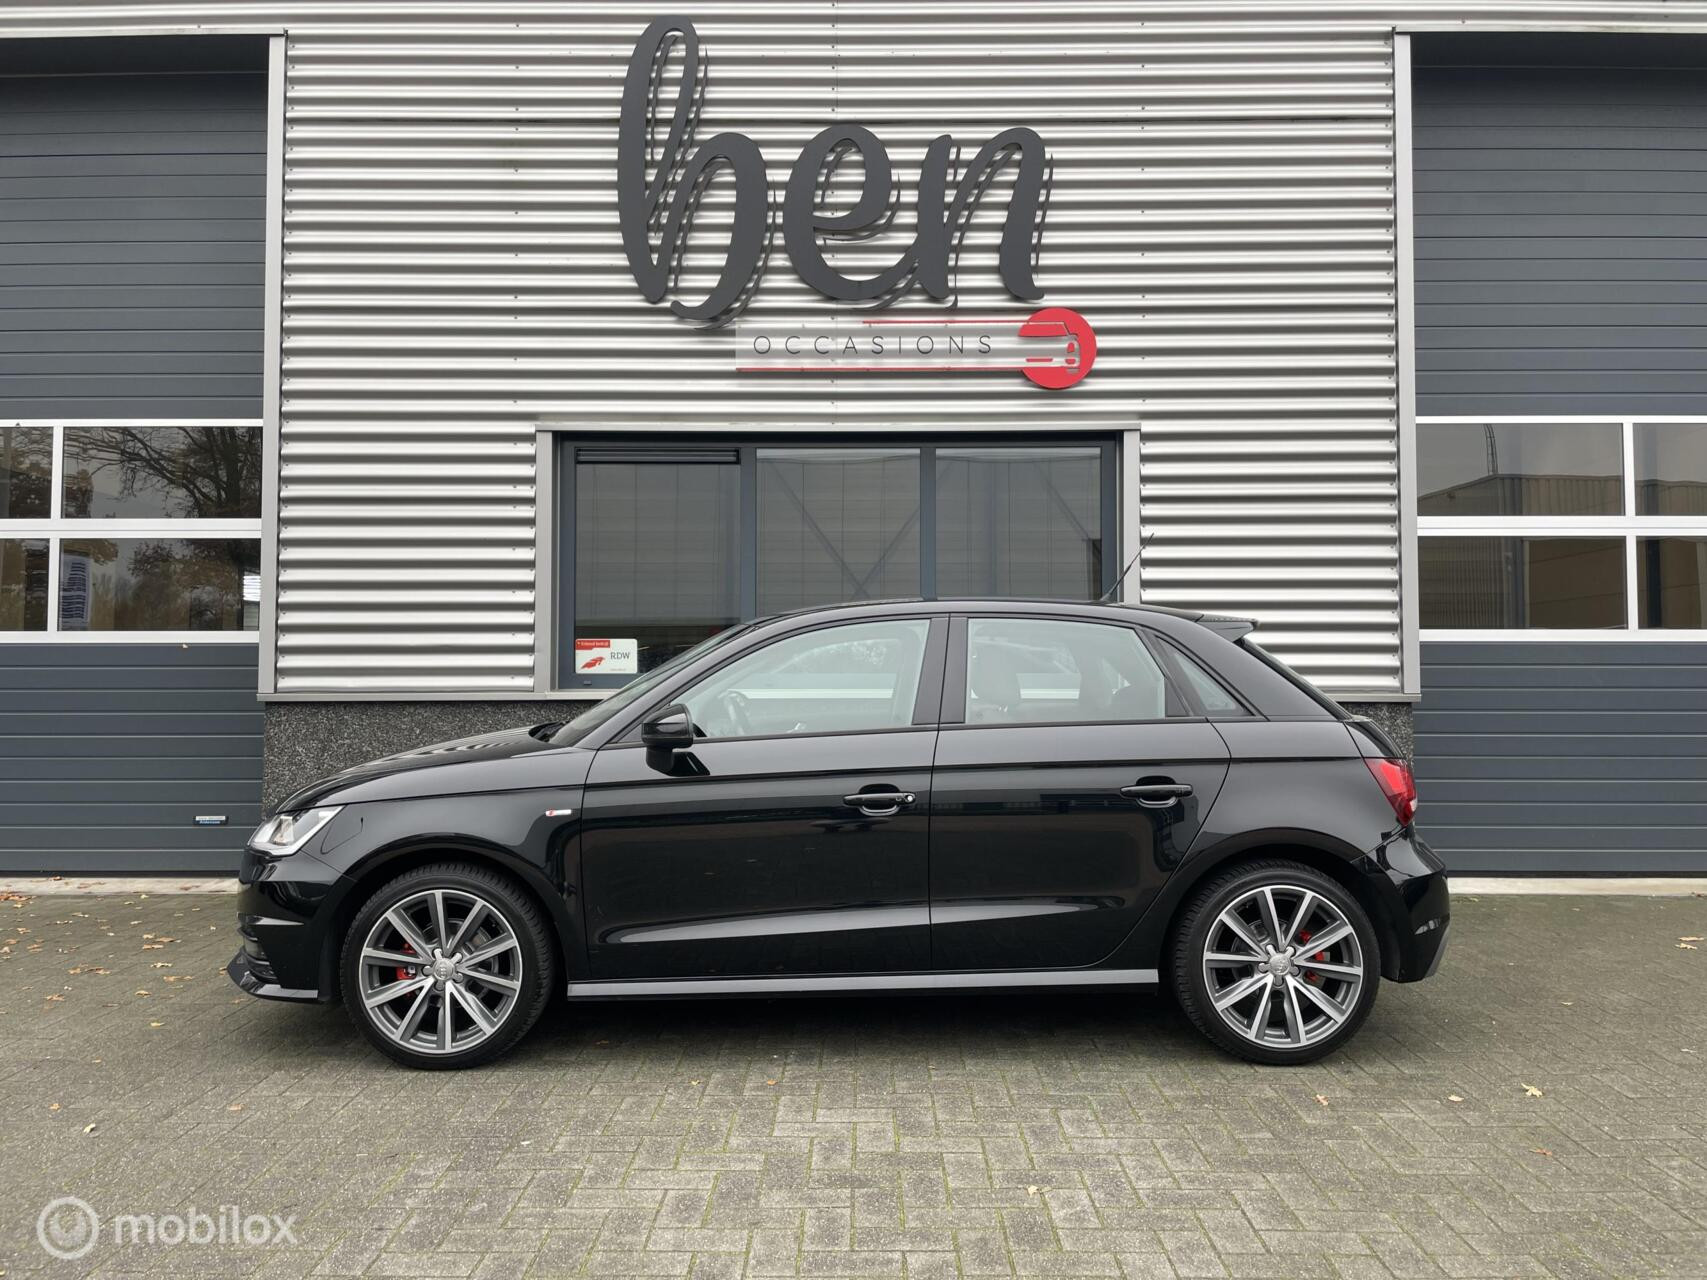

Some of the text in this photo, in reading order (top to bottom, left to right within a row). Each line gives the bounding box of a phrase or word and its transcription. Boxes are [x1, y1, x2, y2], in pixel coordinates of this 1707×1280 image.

[617, 15, 1045, 320] ben
[753, 334, 993, 355] OCCASIONS
[610, 652, 630, 660] RDW
